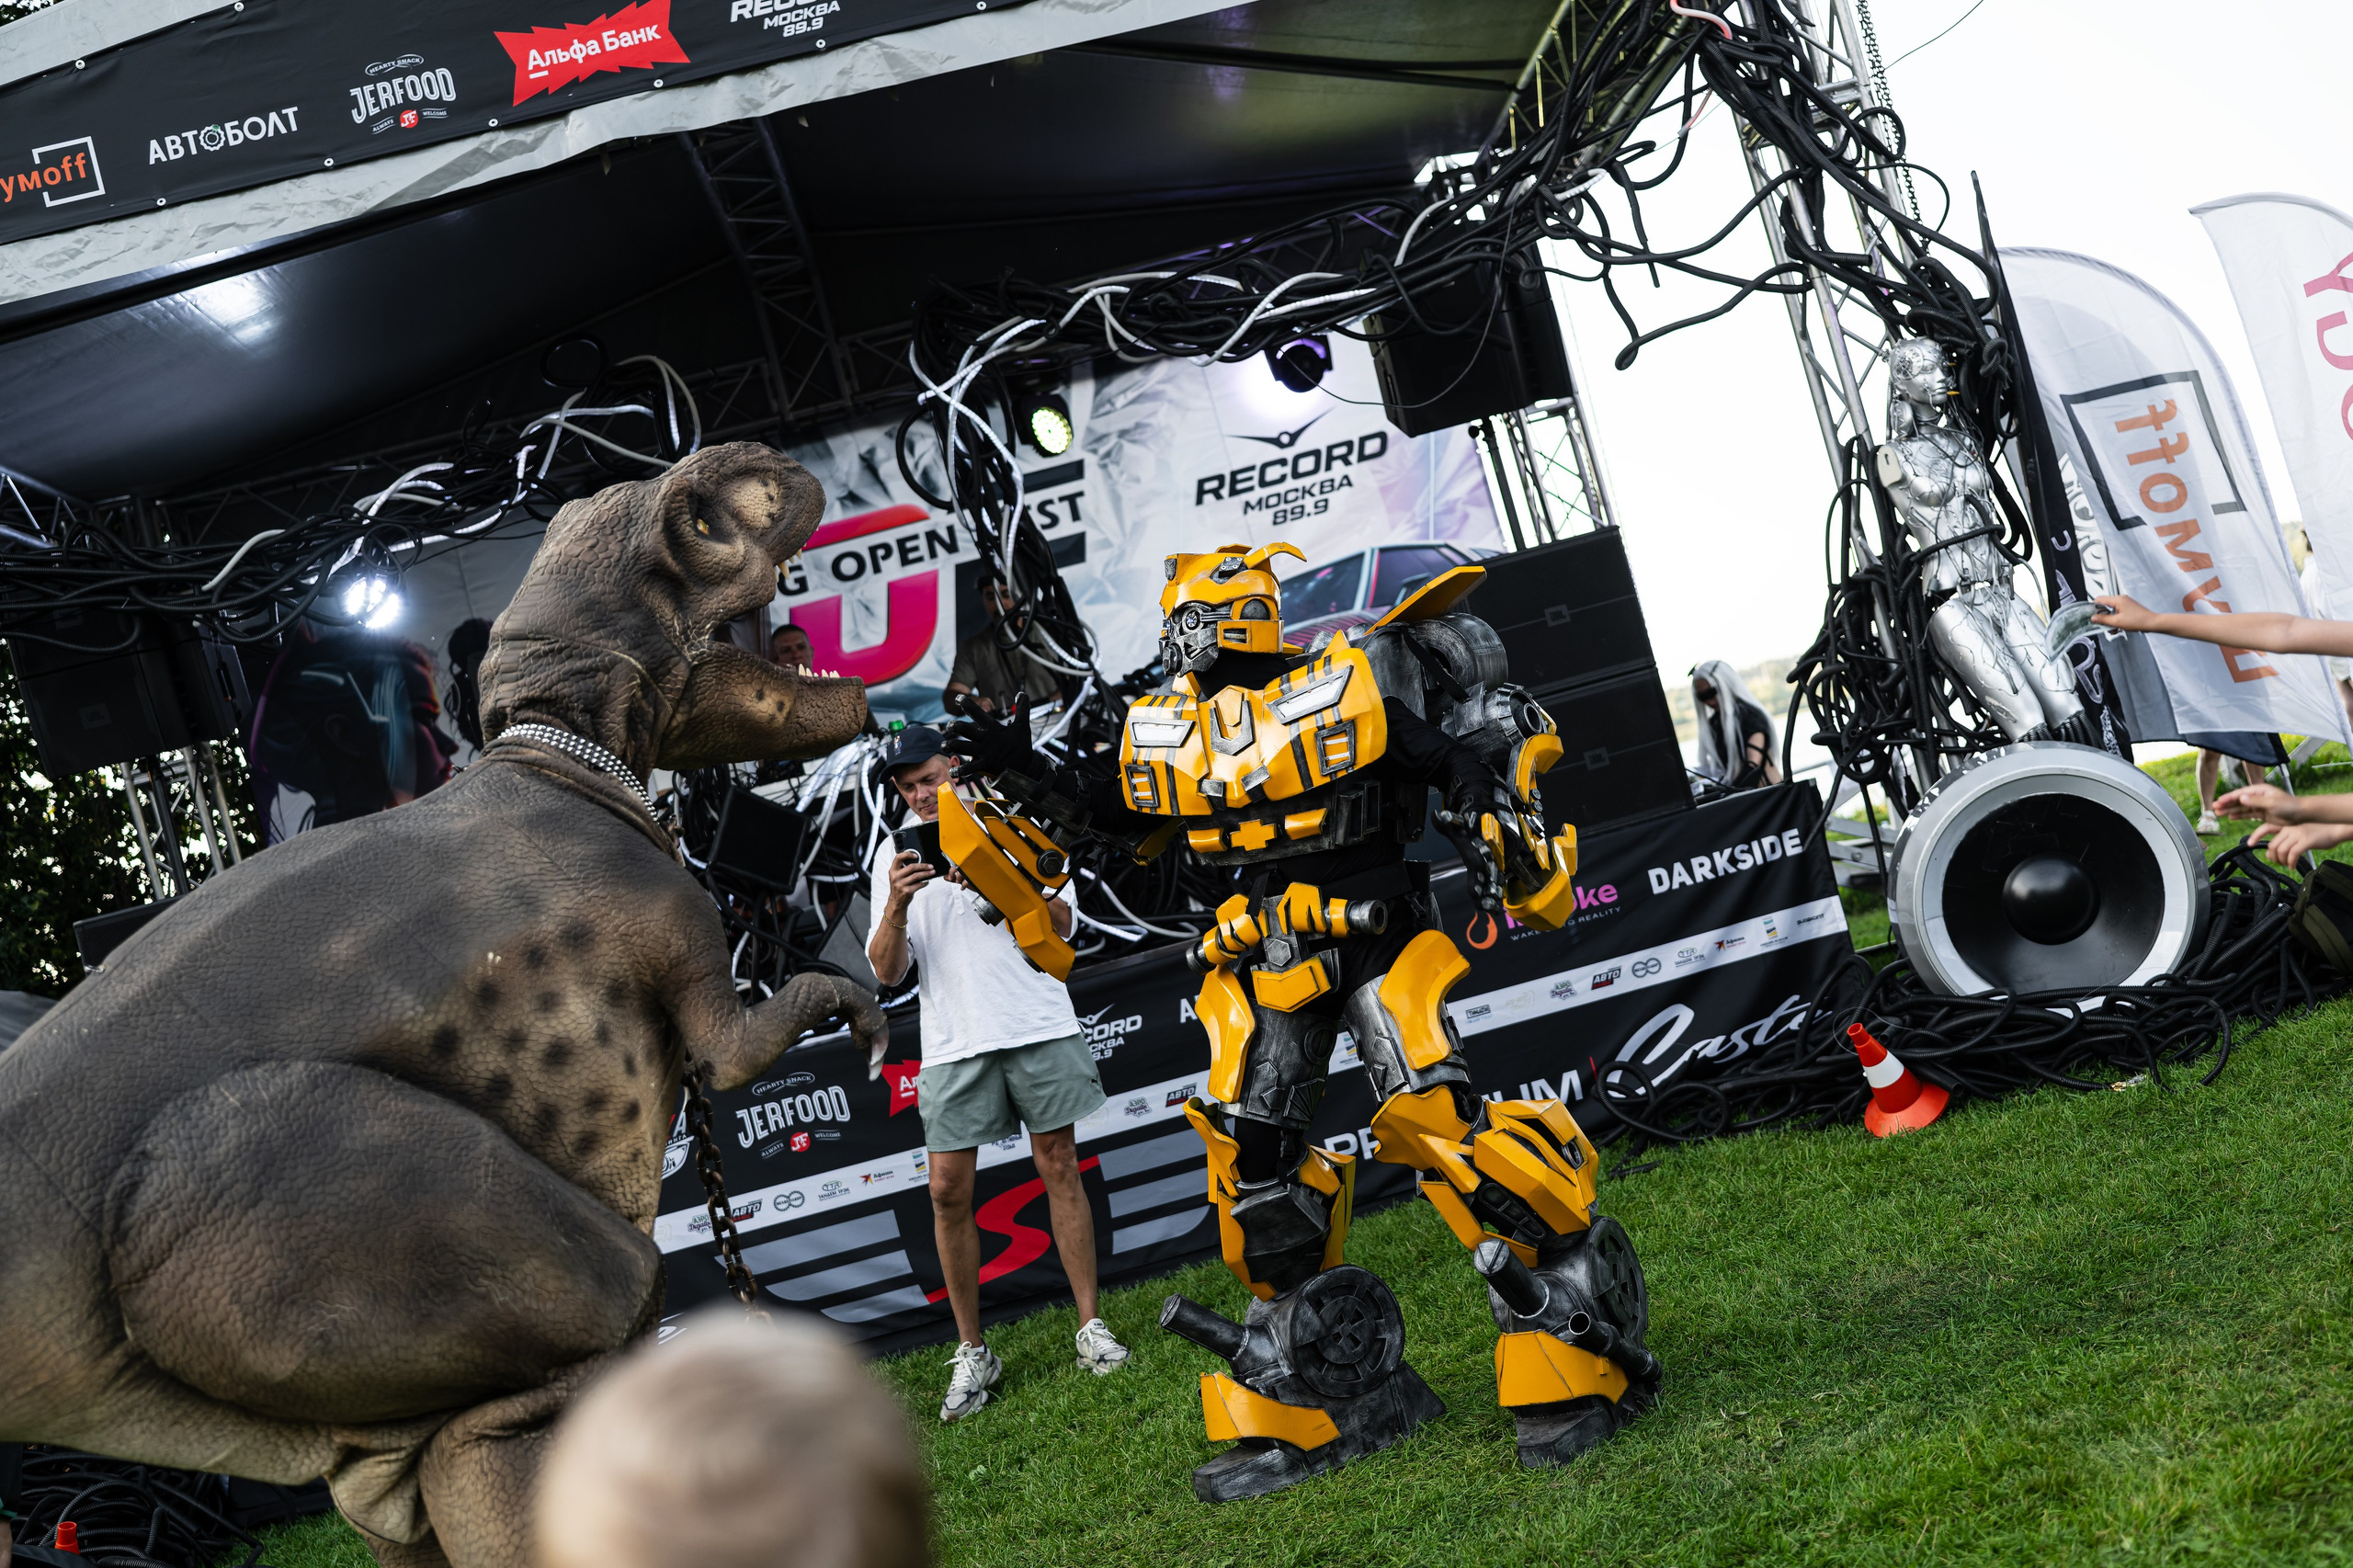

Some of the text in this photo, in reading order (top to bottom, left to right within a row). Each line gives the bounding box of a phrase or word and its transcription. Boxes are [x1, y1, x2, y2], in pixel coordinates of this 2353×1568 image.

[763, 0, 841, 29] МОСКВА
[782, 17, 824, 38] 89.9
[527, 24, 663, 71] Альфа Банк
[369, 57, 421, 74] HEARTY SNACK
[349, 67, 457, 124] JERFOOD
[149, 106, 299, 165] АВТОБОЛТ
[0, 152, 86, 202] умoff
[1195, 431, 1388, 506] RECORD
[1244, 474, 1353, 516] МОСКВА
[1272, 498, 1329, 527] 89.9
[831, 524, 961, 582] OPEN
[1647, 828, 1804, 895] DARKSIDE
[1578, 906, 1621, 923] REALITY
[1594, 970, 1620, 983] АВТО
[1085, 1015, 1142, 1043] CORD
[1088, 1036, 1125, 1053] СКВА
[1093, 1048, 1113, 1062] 9.9
[756, 1075, 812, 1094] HEARTY SNACK
[1168, 1087, 1195, 1100] АВТО
[735, 1085, 851, 1149] JERFOOD
[761, 1142, 785, 1156] ALWAYS
[733, 1203, 760, 1217] АВТО
